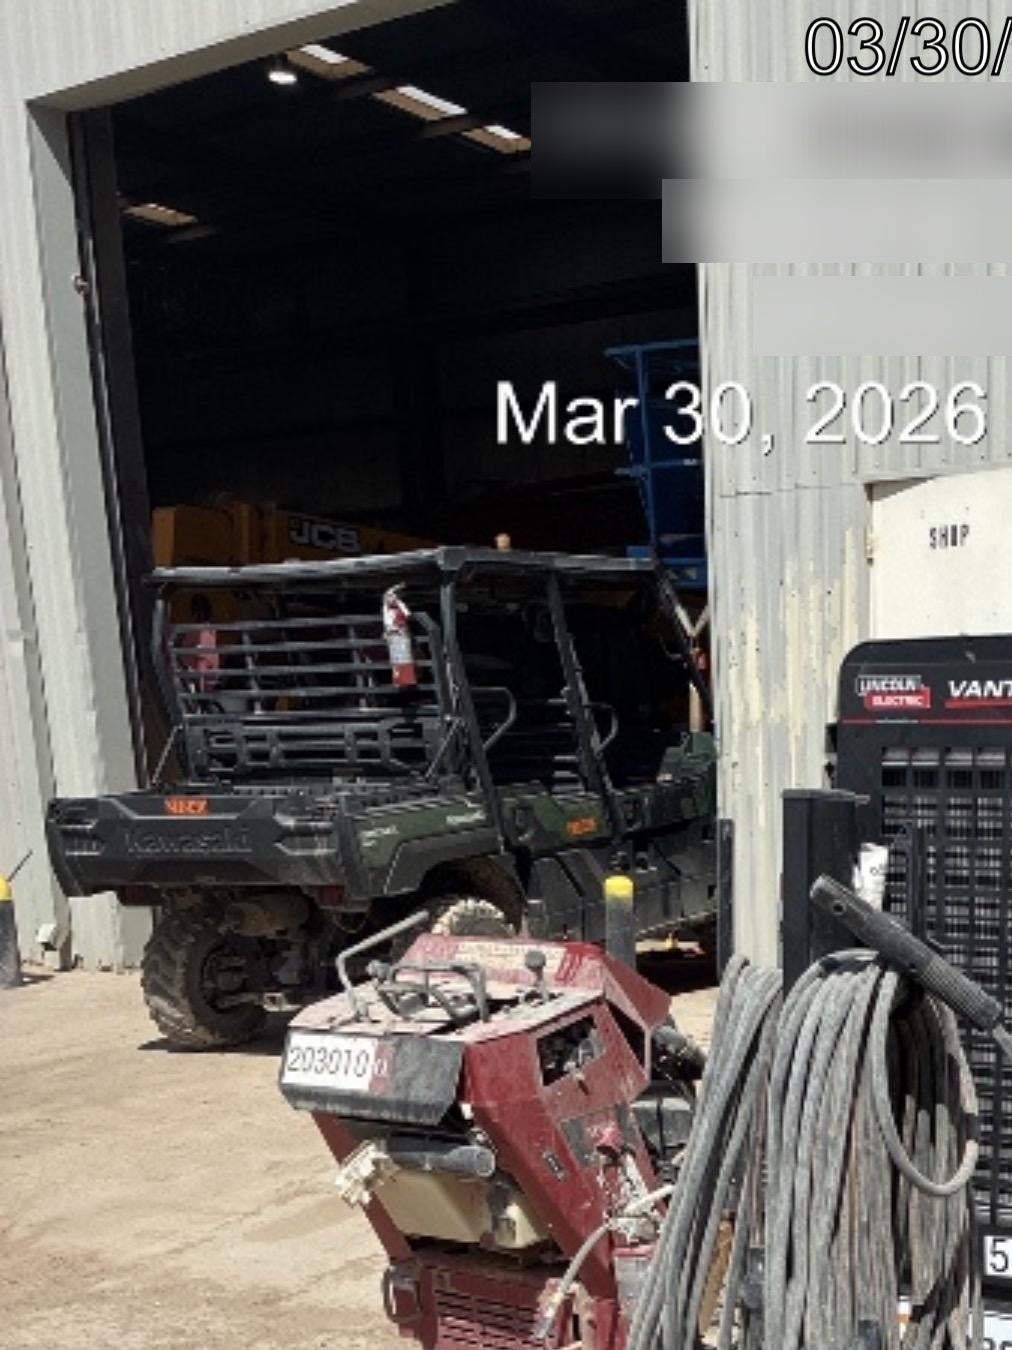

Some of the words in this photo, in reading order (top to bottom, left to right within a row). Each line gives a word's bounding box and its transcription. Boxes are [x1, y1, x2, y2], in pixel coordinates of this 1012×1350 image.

[289, 521, 359, 553] JCB
[928, 524, 970, 551] SHOP
[124, 826, 253, 857] Kawasaki
[287, 1046, 369, 1078] 203010
